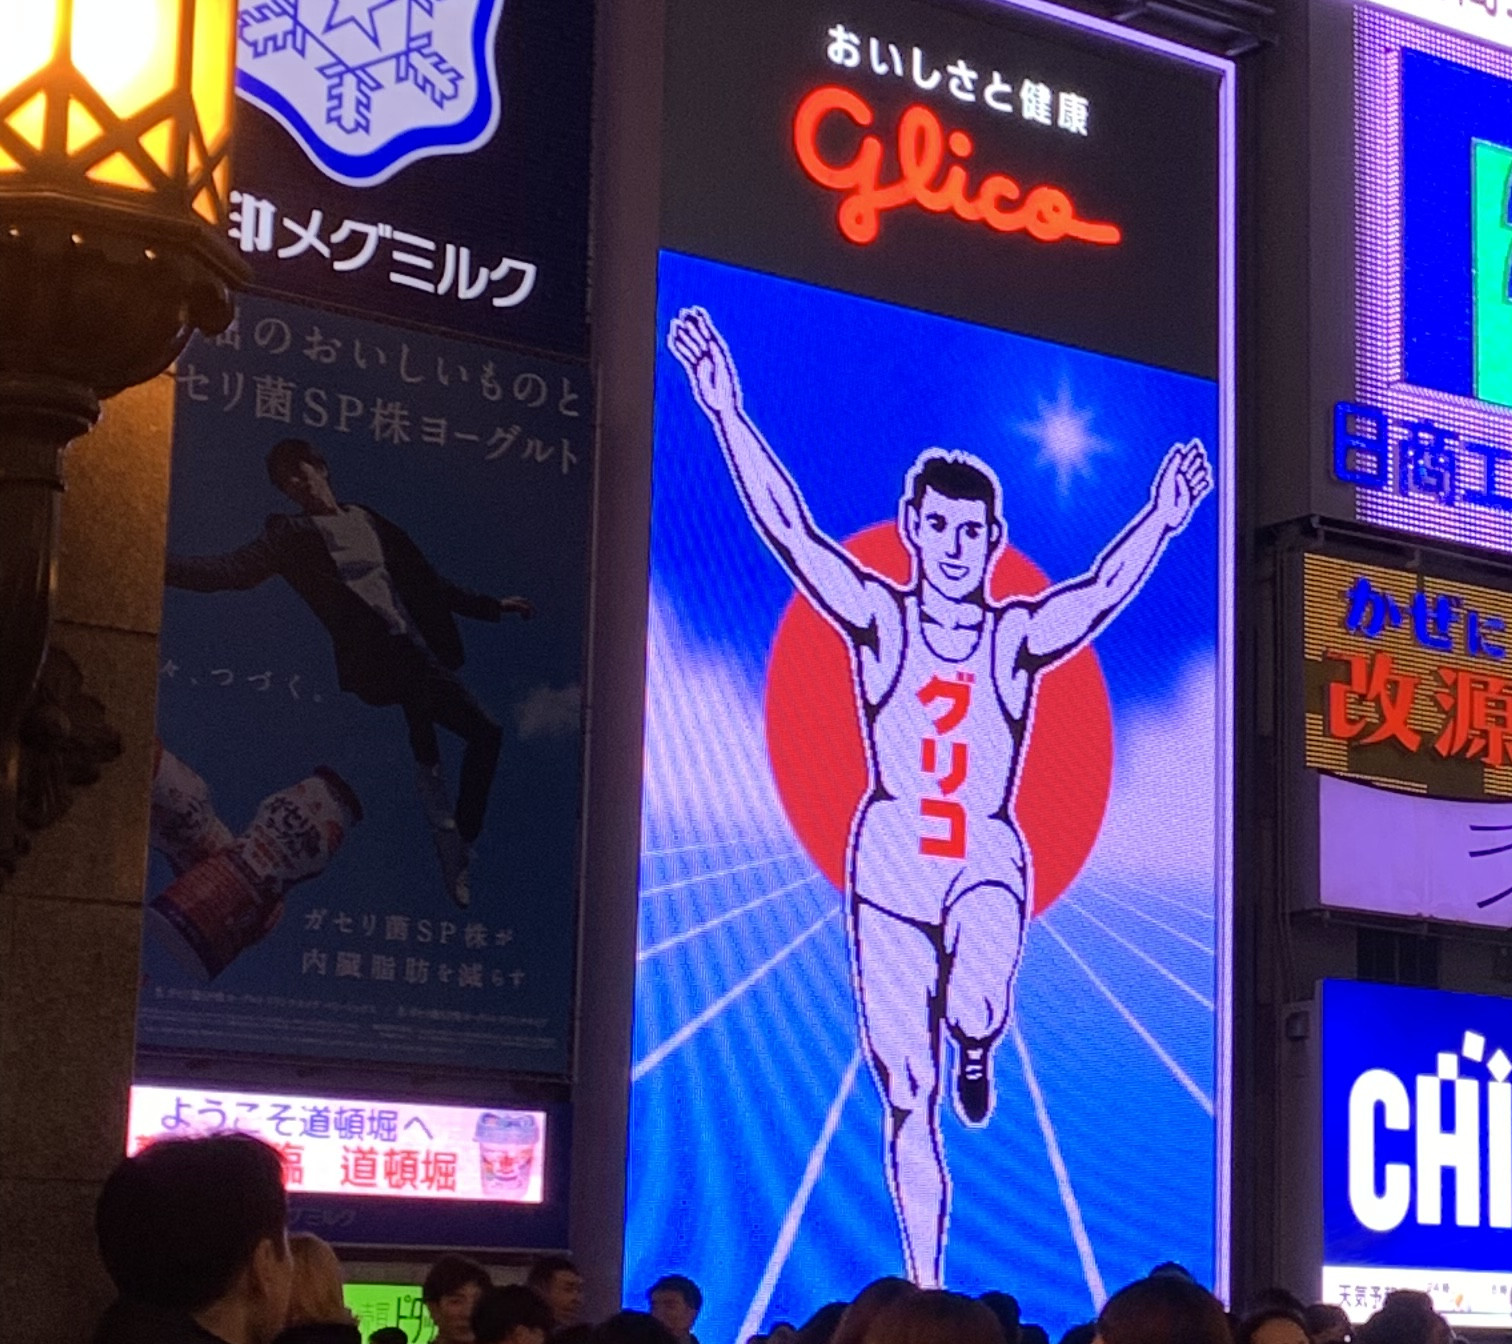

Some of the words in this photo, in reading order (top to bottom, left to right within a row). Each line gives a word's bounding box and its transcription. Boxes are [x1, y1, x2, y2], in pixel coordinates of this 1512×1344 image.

[827, 24, 1090, 136] おいしさと健康
[915, 671, 976, 860] グリコ
[340, 1144, 458, 1192] 道頓堀
